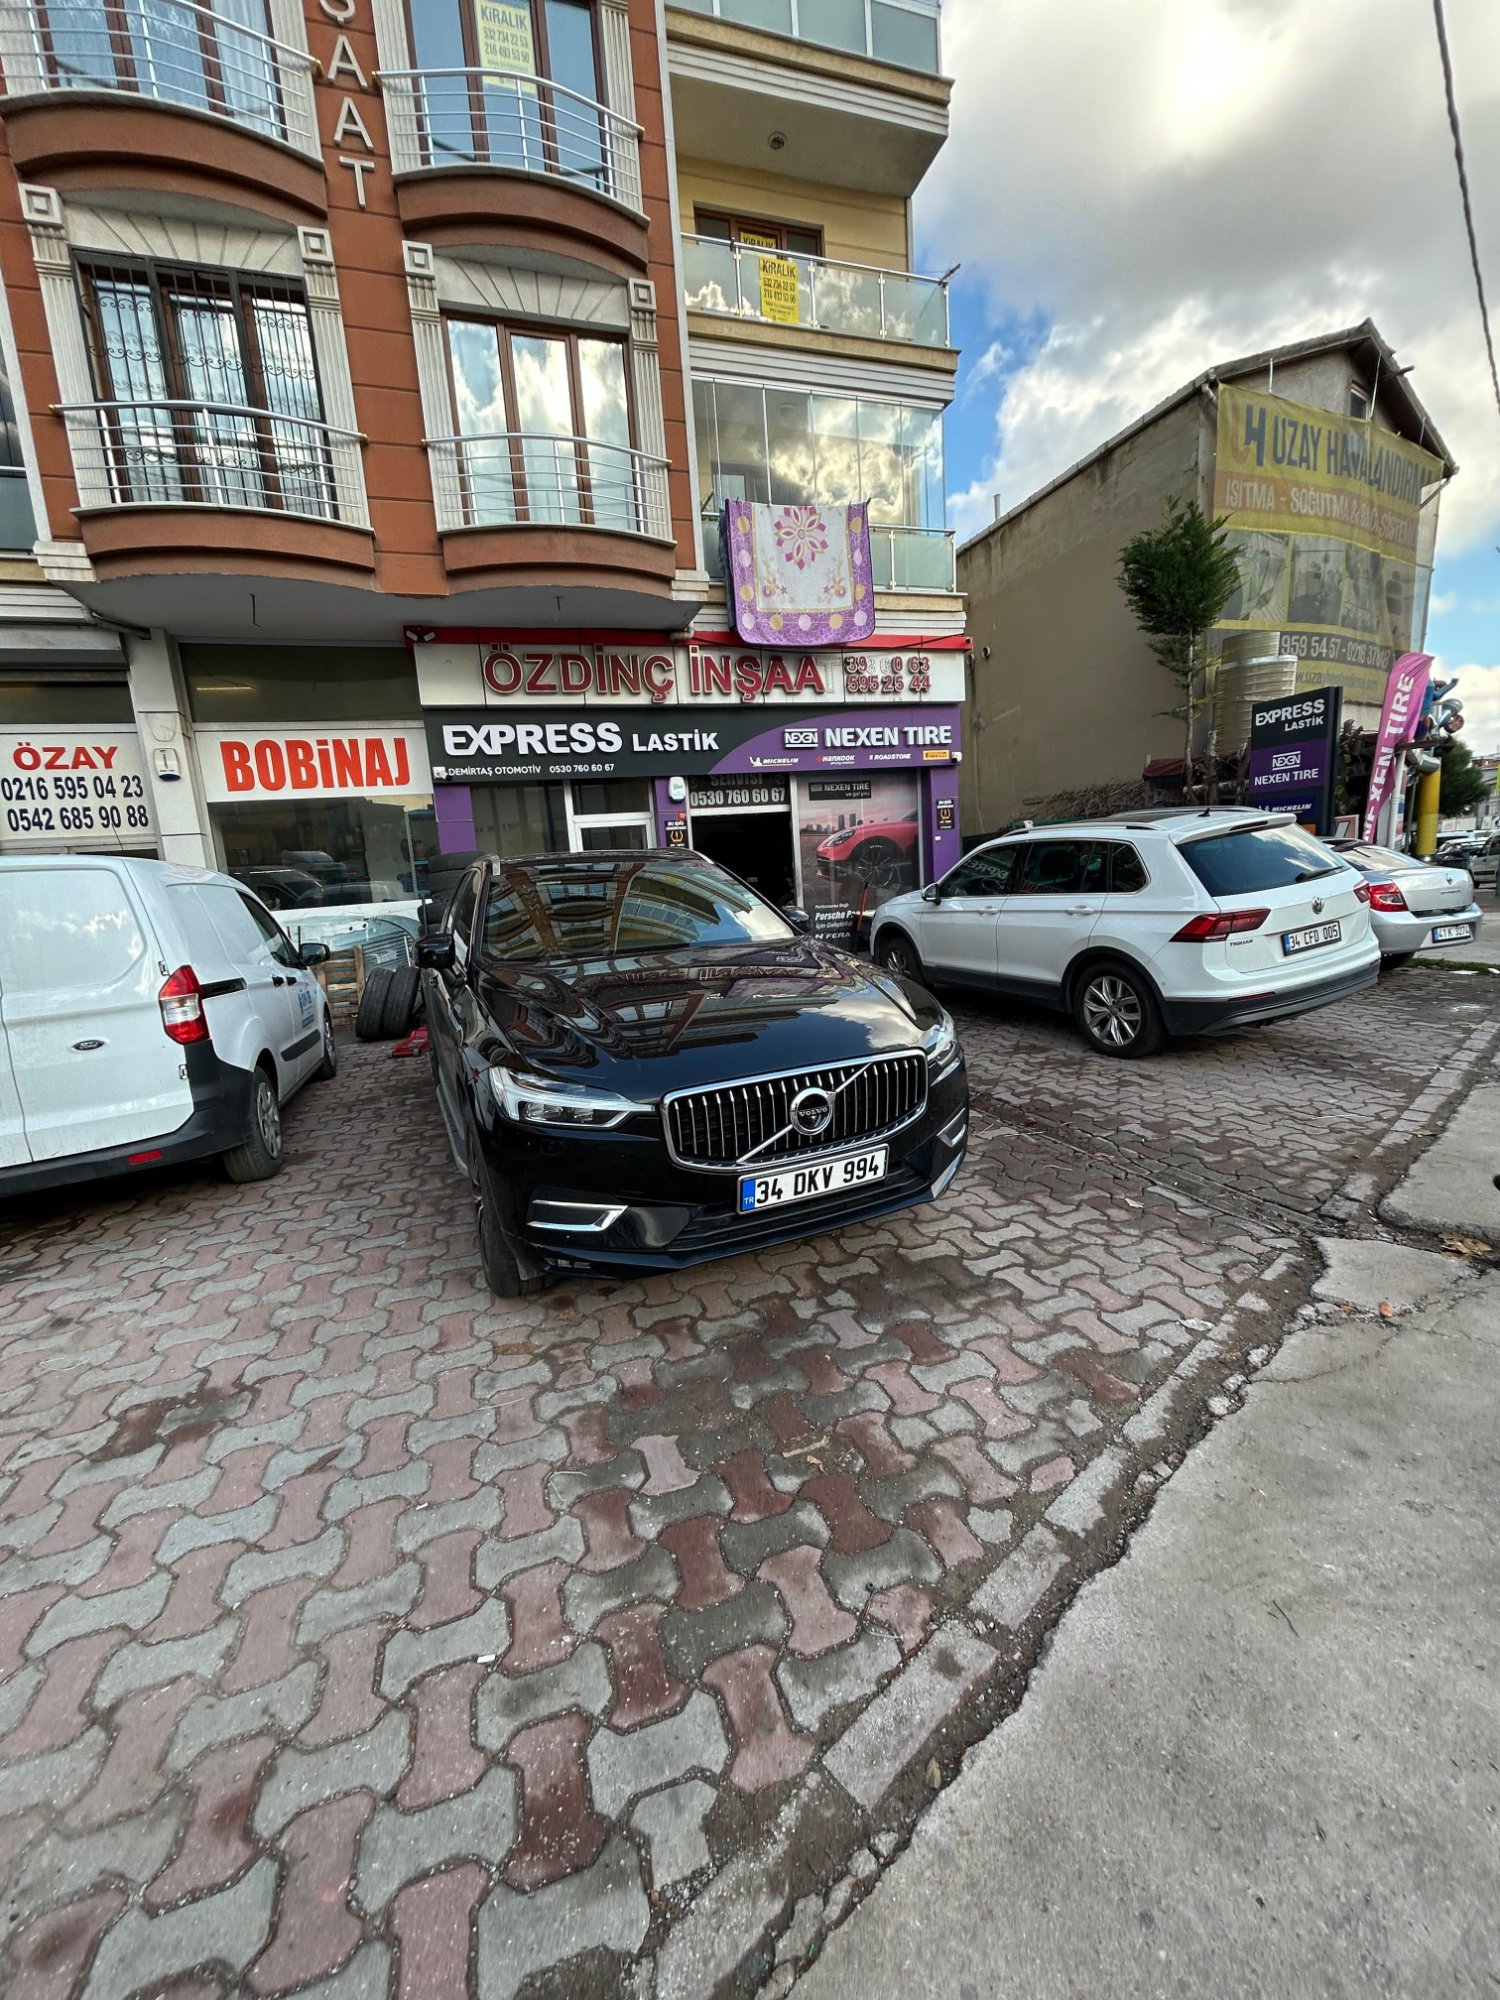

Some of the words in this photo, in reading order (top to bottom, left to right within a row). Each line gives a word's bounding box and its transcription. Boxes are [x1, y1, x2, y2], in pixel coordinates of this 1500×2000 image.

[1272, 415, 1322, 471] UZAY
[1225, 479, 1275, 511] ISITMA
[1281, 635, 1308, 657] 959
[483, 642, 675, 703] ÖZDİNÇ
[846, 674, 880, 693] 595
[880, 674, 905, 693] 25
[909, 674, 931, 692] 44
[1255, 699, 1325, 726] EXPRESS
[1385, 673, 1415, 739] TIRE
[1284, 715, 1324, 732] LASTİK
[442, 722, 623, 756] EXPRESS
[632, 729, 720, 752] LASTİK
[825, 727, 899, 748] NEXEN
[903, 725, 952, 745] TIRE
[13, 742, 118, 771] ÖZAY
[763, 757, 799, 765] MICHELIN
[448, 765, 493, 777] DEMİRTAŞ
[494, 765, 542, 775] OTOMOTİV
[549, 765, 572, 773] 0530
[573, 764, 590, 773] 760
[591, 764, 603, 772] 60
[604, 763, 615, 771] 67
[1254, 772, 1290, 786] NEXEN
[1292, 768, 1319, 781] TIRE
[1, 777, 49, 801] 0216
[53, 776, 89, 799] 595
[93, 775, 117, 798] 04
[120, 775, 143, 798] 23
[690, 790, 724, 806] 0530
[725, 788, 750, 804] 760
[752, 788, 769, 802] 60
[771, 787, 785, 802] 67
[852, 783, 869, 791] TIRE
[7, 807, 55, 831] 0542
[59, 806, 94, 830] 685
[98, 805, 121, 828] 90
[126, 805, 149, 827] 88
[1271, 803, 1312, 813] MICHELIN
[1290, 935, 1300, 949] 34
[1323, 924, 1338, 940] 005
[798, 1106, 828, 1116] VOLVO
[756, 1178, 784, 1205] 34
[793, 1165, 834, 1194] DKV
[843, 1154, 881, 1184] 994
[744, 1196, 755, 1205] TR
